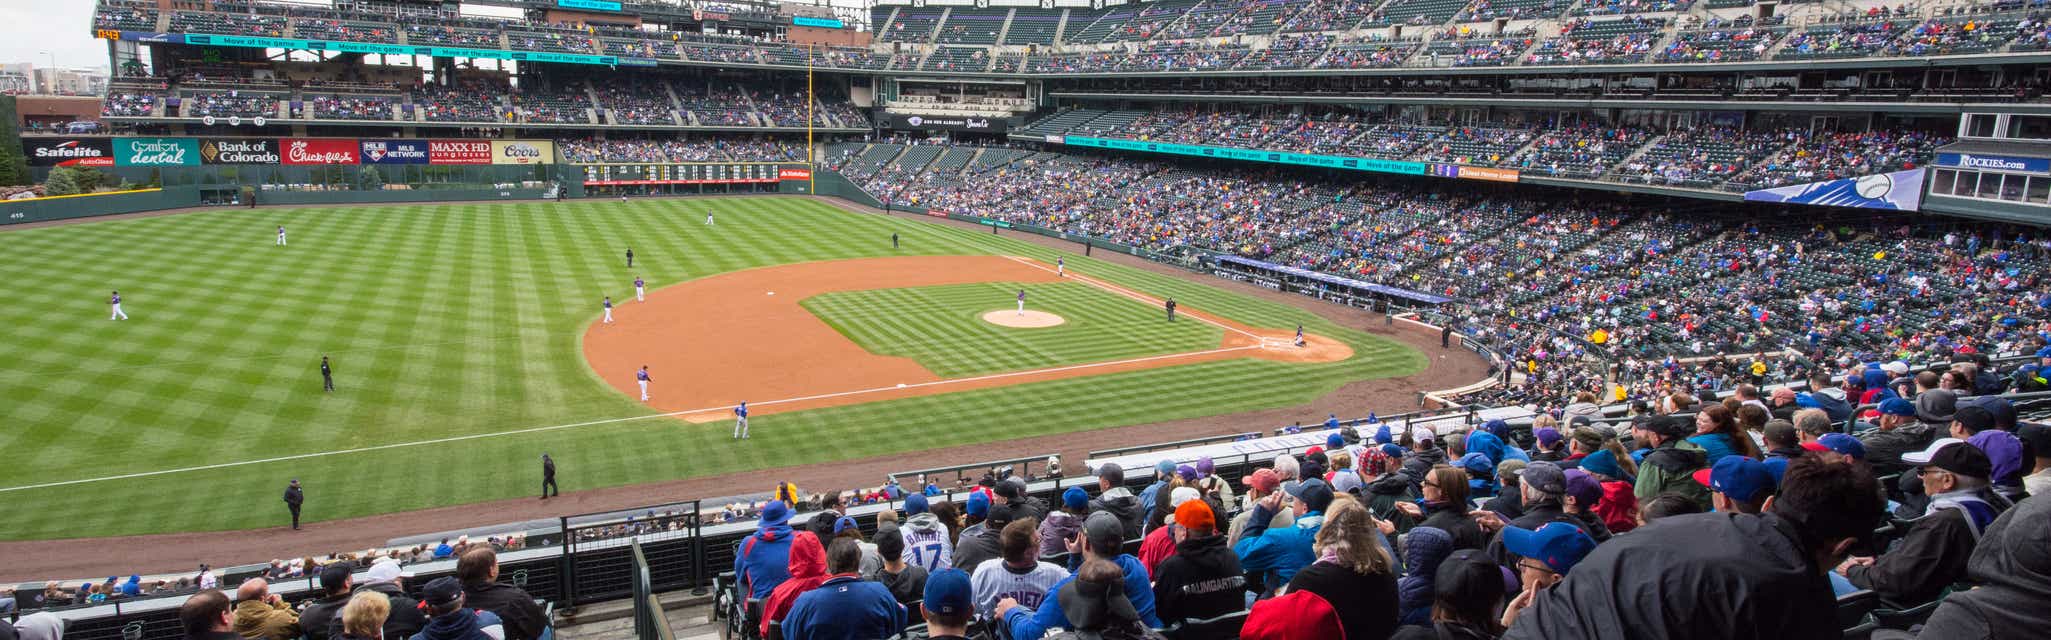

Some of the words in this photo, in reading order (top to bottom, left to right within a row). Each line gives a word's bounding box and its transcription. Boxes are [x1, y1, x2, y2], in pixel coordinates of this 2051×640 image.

[131, 140, 179, 151] Comfort
[218, 141, 251, 151] Bank
[253, 140, 266, 151] of
[431, 143, 470, 151] MAXX
[471, 143, 490, 152] HD
[504, 145, 540, 157] Coors
[36, 147, 102, 157] Safelite
[131, 149, 185, 164] dental
[220, 151, 279, 162] Colorado
[1960, 155, 2025, 169] ROCKIES.com
[906, 530, 941, 545] BRYANT
[911, 544, 942, 572] 17
